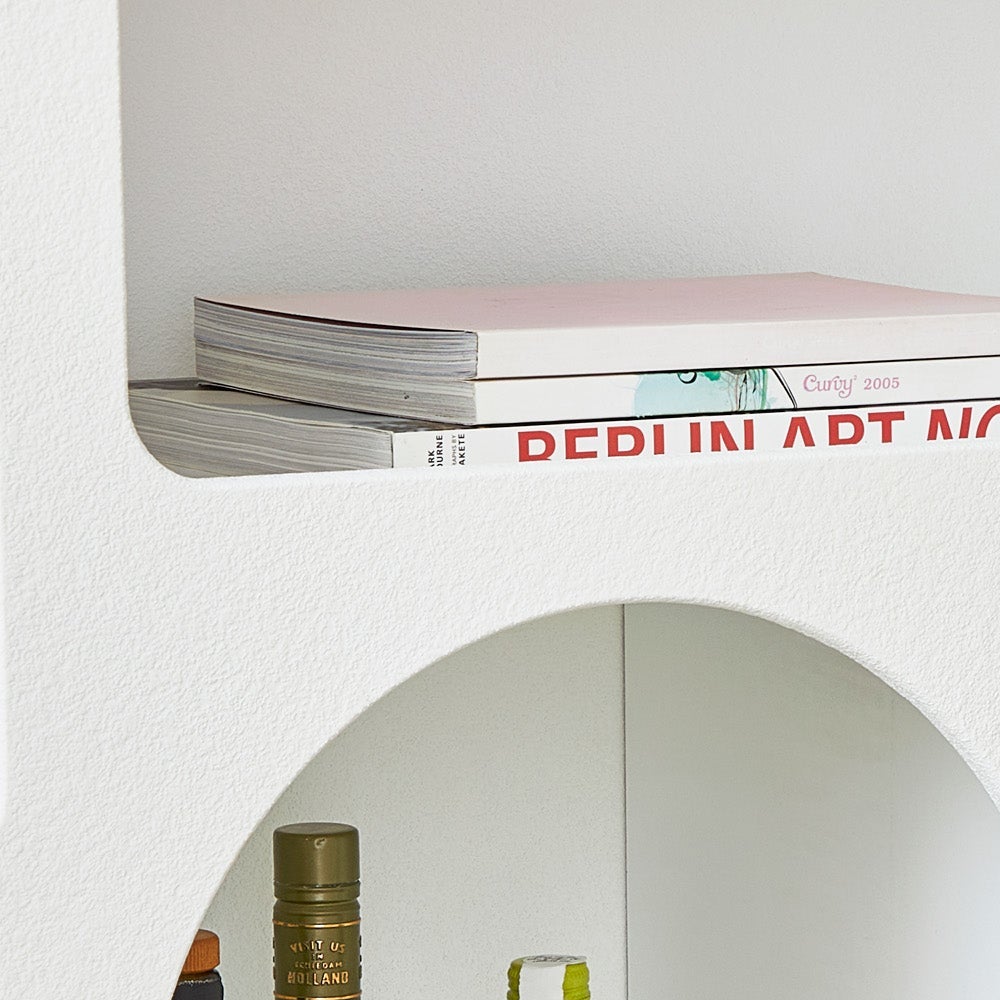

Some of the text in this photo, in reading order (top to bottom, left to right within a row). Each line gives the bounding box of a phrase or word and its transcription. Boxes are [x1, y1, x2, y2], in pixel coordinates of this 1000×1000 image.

[863, 377, 900, 391] 2005
[290, 940, 346, 954] VISIT US
[287, 971, 349, 986] HOLLAND
